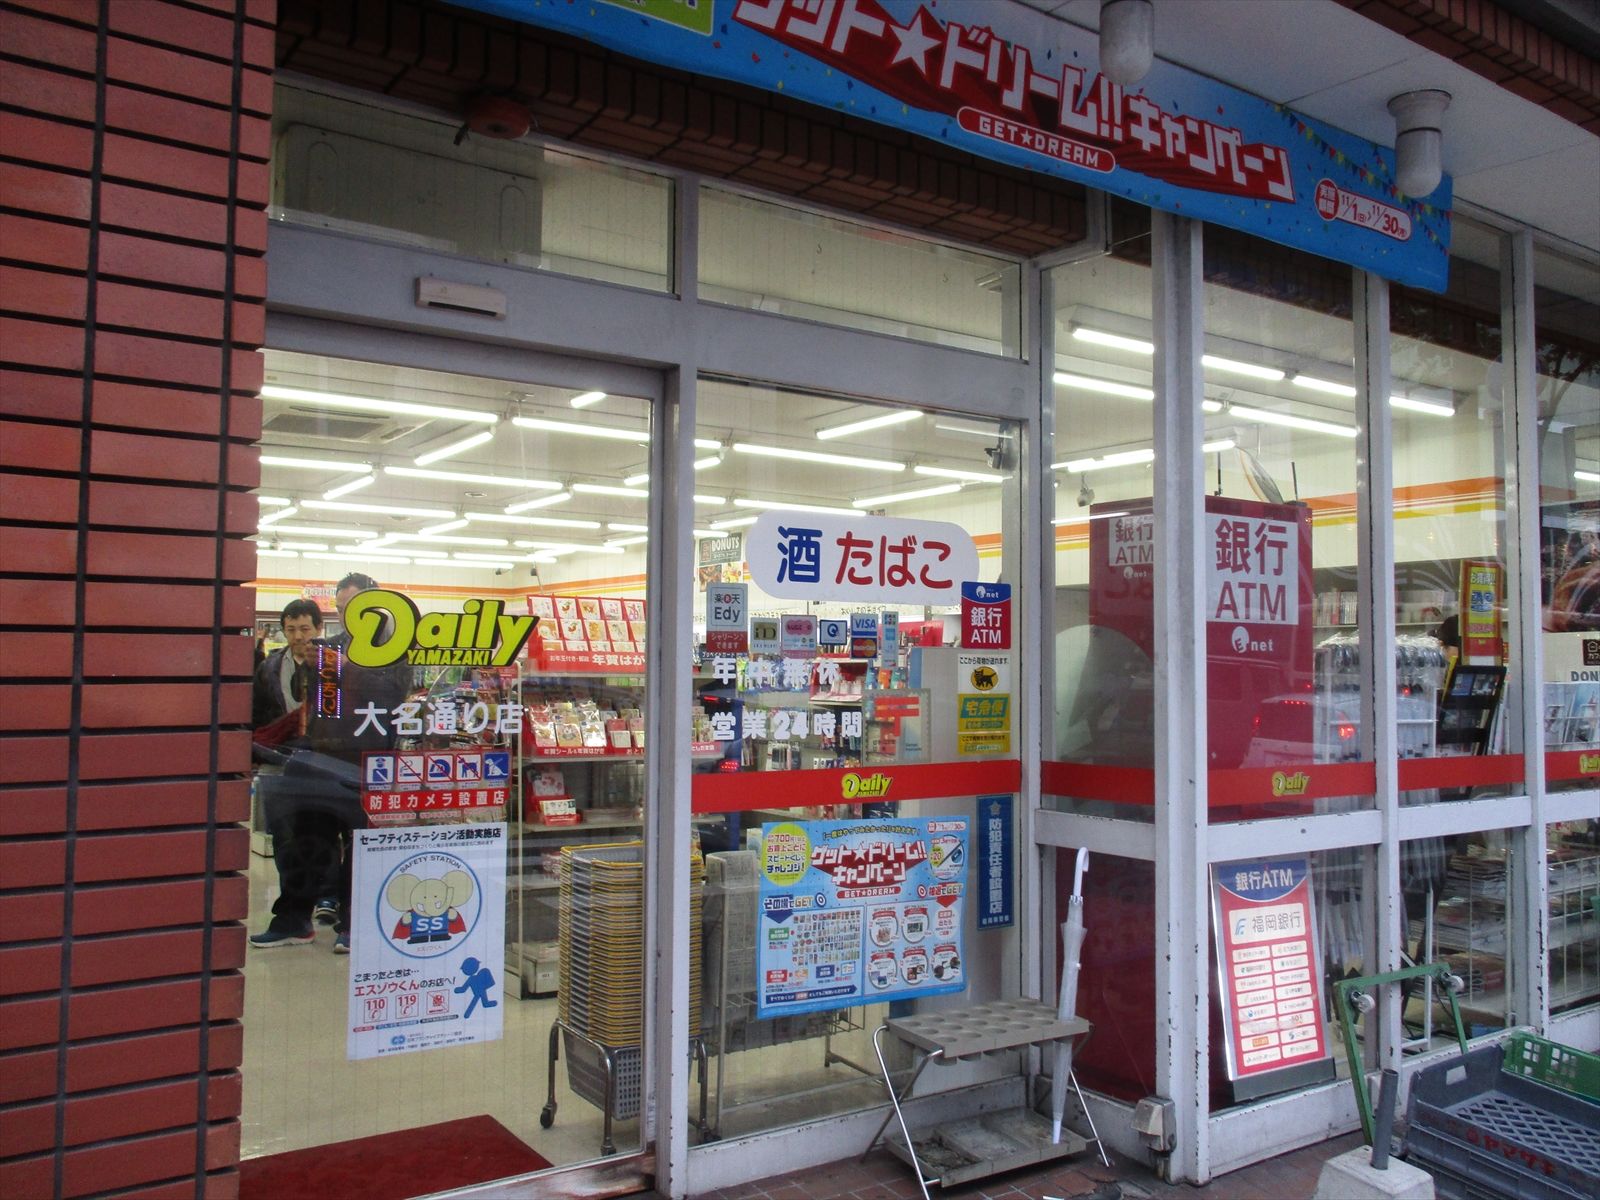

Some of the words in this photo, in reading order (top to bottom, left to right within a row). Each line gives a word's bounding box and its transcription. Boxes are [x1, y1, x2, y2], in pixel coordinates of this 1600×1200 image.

[711, 536, 740, 551] DONUTS
[1215, 518, 1288, 576] 銀行
[776, 525, 823, 583] 酒
[835, 530, 953, 589] たばこ
[1115, 544, 1154, 564] ATM
[1215, 581, 1287, 622] ATM
[714, 606, 741, 623] Edy
[854, 618, 876, 629] VISA
[970, 607, 1003, 627] 銀行
[344, 590, 540, 668] Daily
[970, 629, 1002, 644] ATM
[407, 649, 490, 665] YAMAZAKI
[711, 657, 841, 685] 年中無休
[353, 701, 524, 738] 大名通り店
[711, 710, 863, 740] 営業24時間
[841, 773, 894, 799] Daily
[1272, 772, 1310, 796] Daily
[369, 791, 505, 811] 防犯カメラ設置店
[360, 828, 502, 846] セーフティステーション活動実施店
[400, 855, 428, 873] SAFETY
[430, 855, 462, 869] STATION
[832, 862, 906, 885] キャンペーン
[1235, 868, 1294, 892] 銀行ATM
[416, 917, 444, 932] SS
[1252, 911, 1301, 934] 福岡銀行
[366, 999, 385, 1010] 110
[398, 995, 417, 1006] 119
